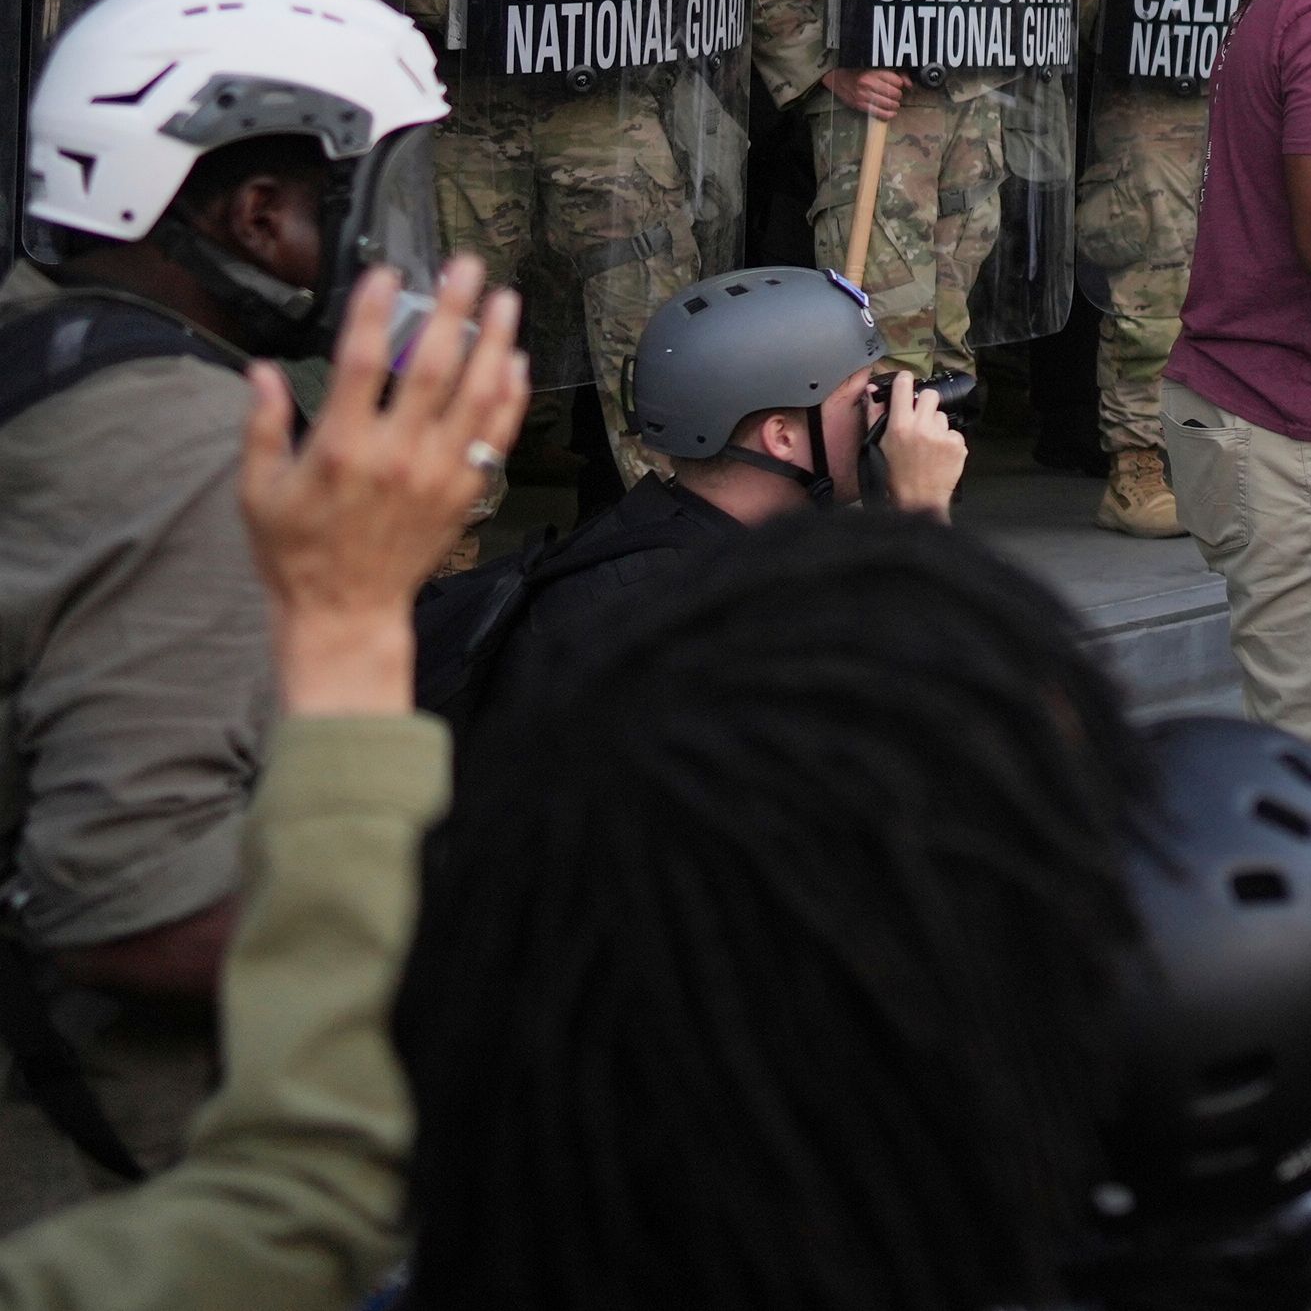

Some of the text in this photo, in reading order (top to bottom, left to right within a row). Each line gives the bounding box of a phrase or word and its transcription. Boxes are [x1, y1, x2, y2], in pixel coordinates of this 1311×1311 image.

[871, 5, 1072, 68] NATIONAL GUARD
[1128, 21, 1228, 79] NATIO
